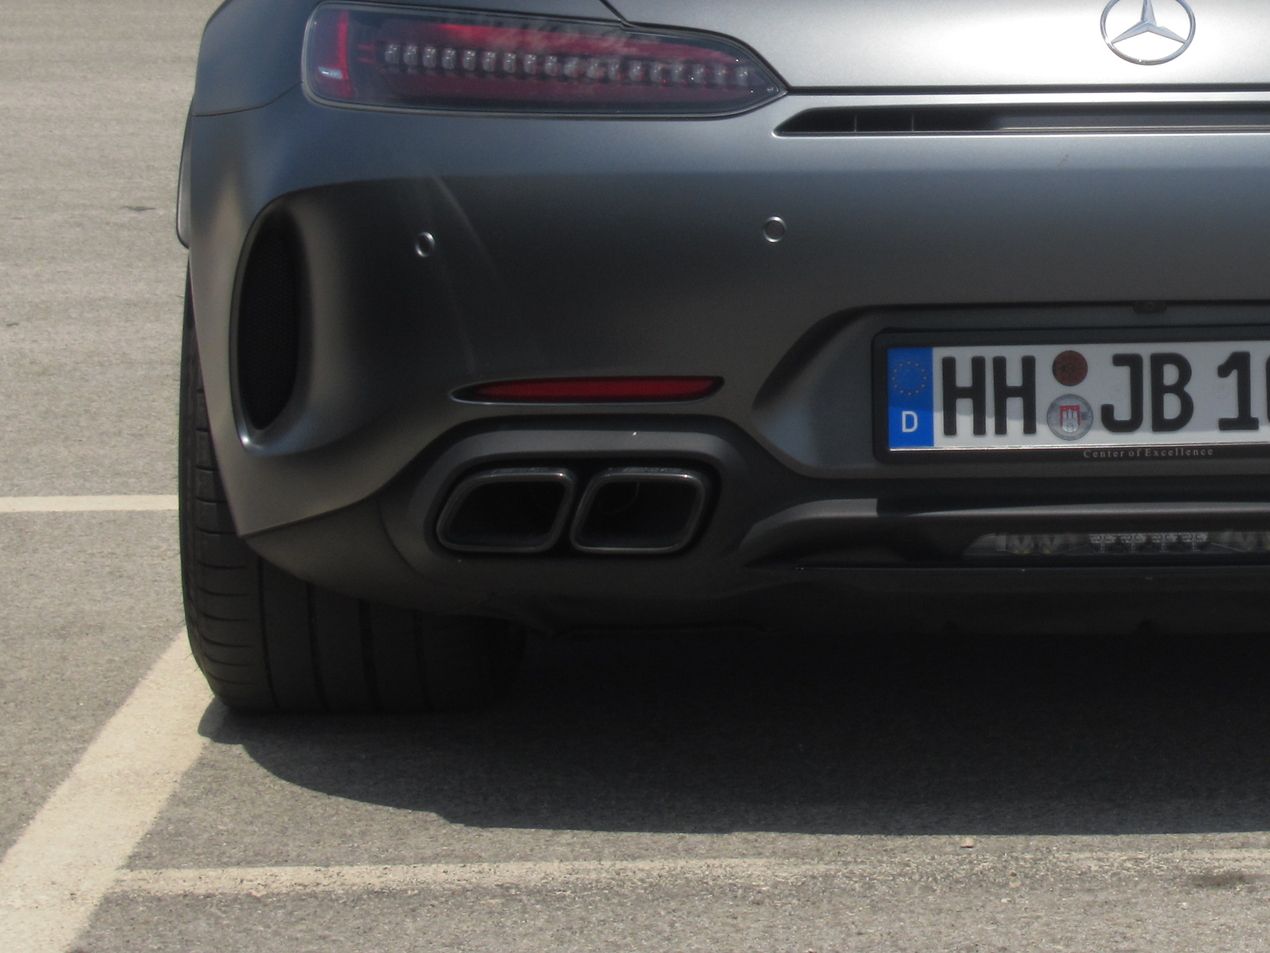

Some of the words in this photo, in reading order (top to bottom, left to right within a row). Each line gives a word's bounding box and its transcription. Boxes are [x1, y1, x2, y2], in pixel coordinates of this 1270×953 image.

[941, 354, 1036, 436] HH
[1100, 352, 1193, 433] JB
[901, 411, 918, 433] D
[1083, 449, 1125, 459] Center
[1128, 448, 1140, 458] of
[1145, 447, 1214, 458] Excellence
